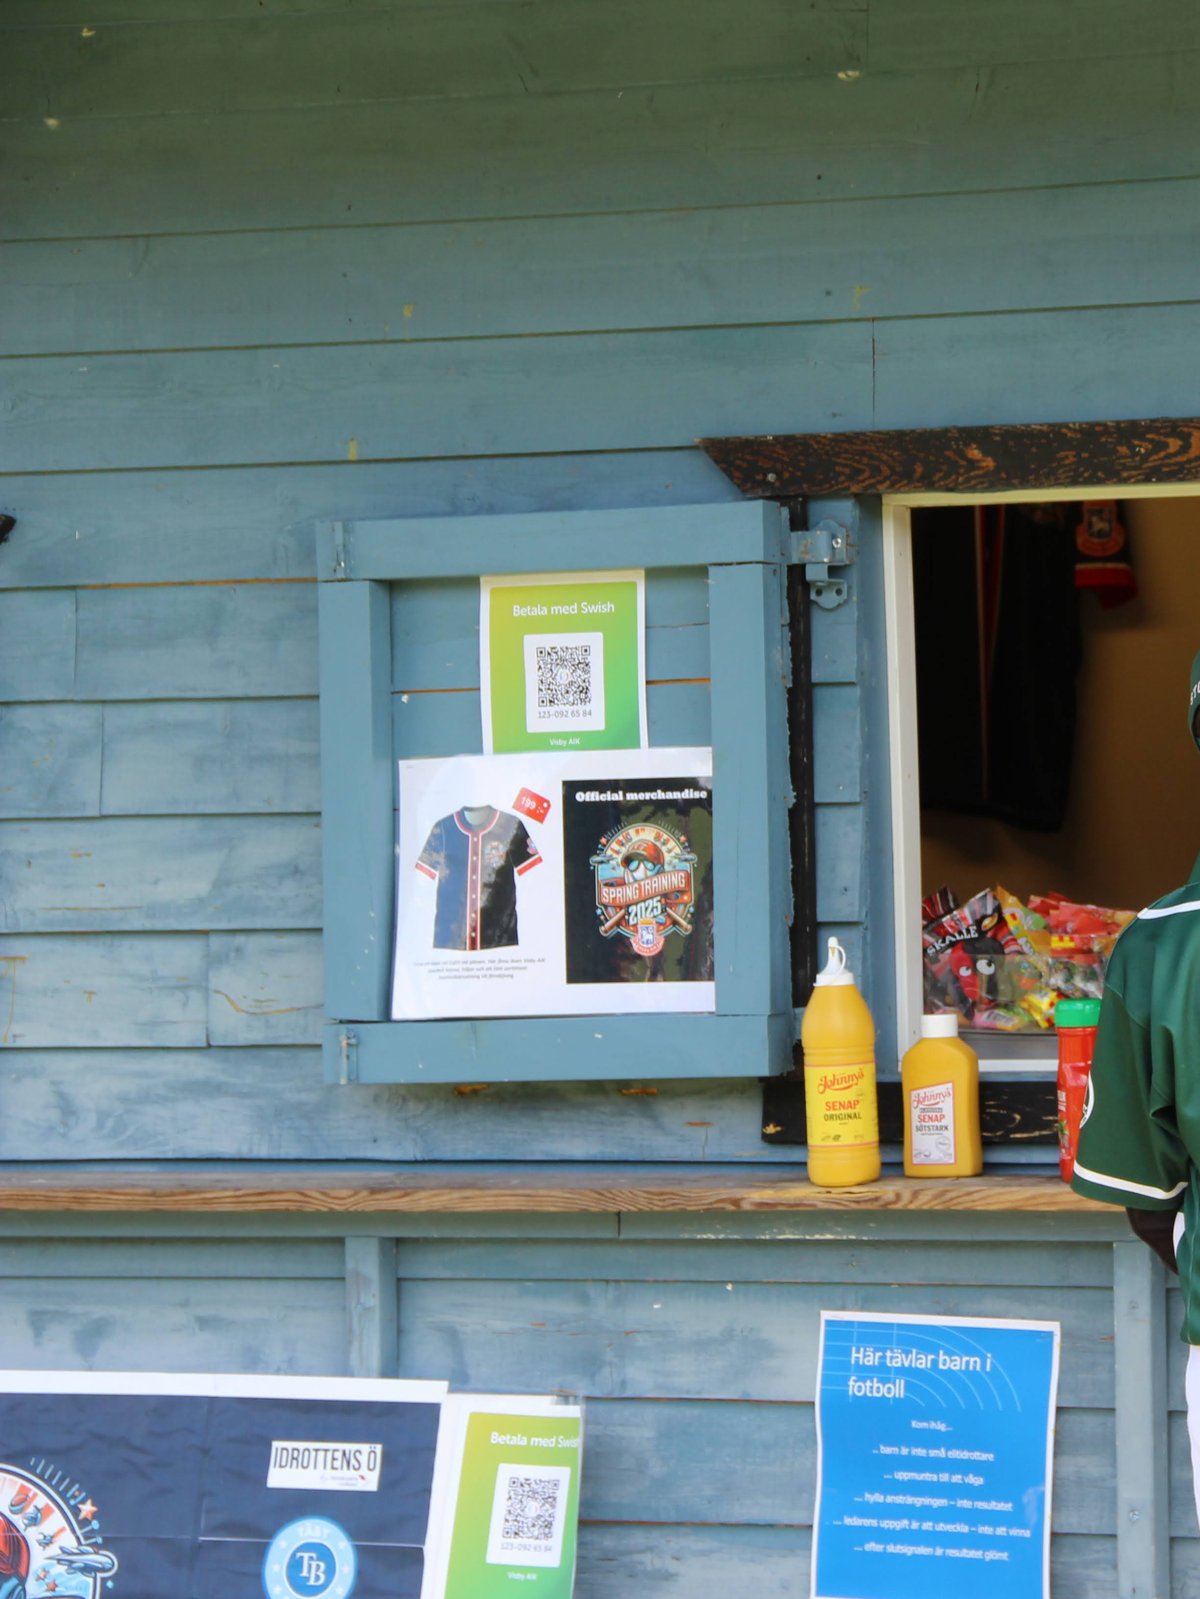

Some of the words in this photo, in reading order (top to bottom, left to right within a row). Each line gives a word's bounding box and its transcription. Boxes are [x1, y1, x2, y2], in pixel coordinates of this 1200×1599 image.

[512, 604, 547, 617] Betala
[551, 602, 577, 615] med
[581, 601, 615, 614] Swish
[538, 710, 569, 719] 123-092
[570, 710, 580, 718] 65
[582, 709, 592, 717] 84
[575, 790, 624, 802] Official
[626, 788, 707, 801] merchandise
[602, 884, 640, 903] SPRING
[641, 872, 686, 895] TRAINING
[628, 896, 661, 925] 2025
[926, 923, 979, 957] SKALLE
[825, 1099, 860, 1111] SENAP
[824, 1112, 862, 1122] ORIGINAL
[917, 1113, 945, 1123] SENAP
[850, 1346, 883, 1366] Här
[885, 1348, 935, 1369] tävlar
[938, 1350, 981, 1371] barn
[986, 1353, 992, 1372] i
[848, 1376, 905, 1398] fotboll
[911, 1420, 929, 1429] Kom
[490, 1431, 527, 1446] Betala
[530, 1435, 556, 1447] med
[273, 1447, 362, 1471] IDROTTENS
[367, 1445, 377, 1472] Ö
[879, 1444, 899, 1455] barn
[900, 1446, 909, 1455] är
[911, 1447, 927, 1456] inte
[928, 1447, 947, 1458] små
[894, 1471, 937, 1482] uppmuntra
[939, 1472, 949, 1483] till
[950, 1474, 963, 1484] att
[964, 1473, 984, 1486] våga
[864, 1491, 885, 1504] hylla
[296, 1552, 326, 1586] TB
